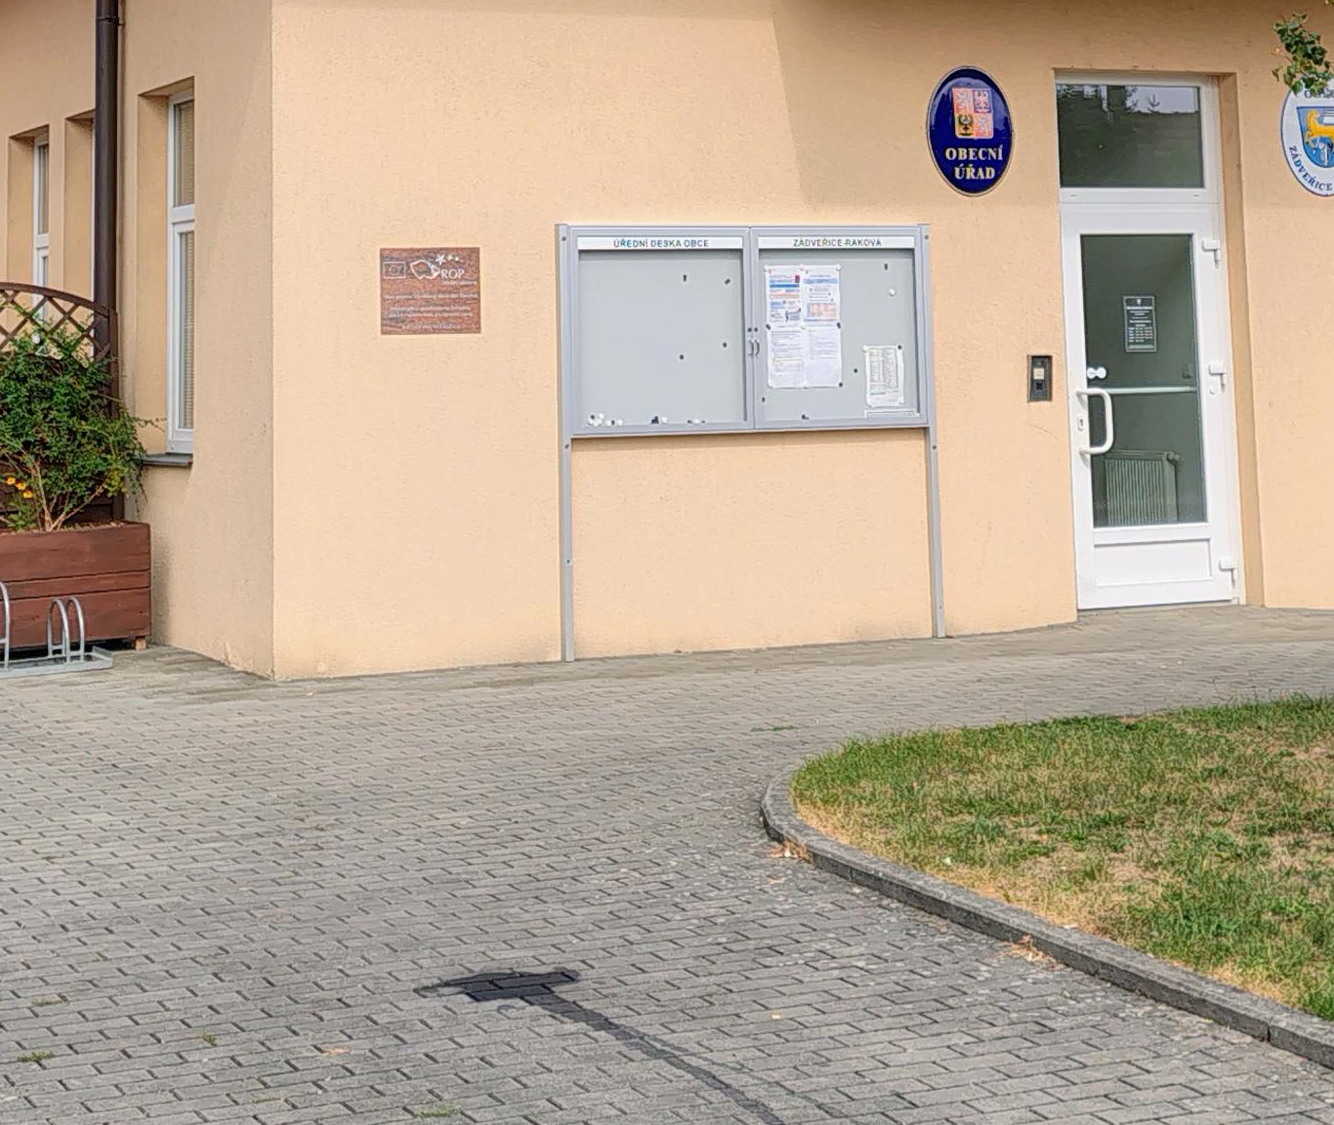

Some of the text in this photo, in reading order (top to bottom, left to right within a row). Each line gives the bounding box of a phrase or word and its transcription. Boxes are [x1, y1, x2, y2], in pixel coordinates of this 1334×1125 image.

[945, 144, 1003, 160] OBECNÍ
[954, 163, 995, 179] ÚŘAD
[651, 239, 681, 247] DESKA
[684, 239, 709, 247] OBCE
[441, 268, 464, 279] ROP
